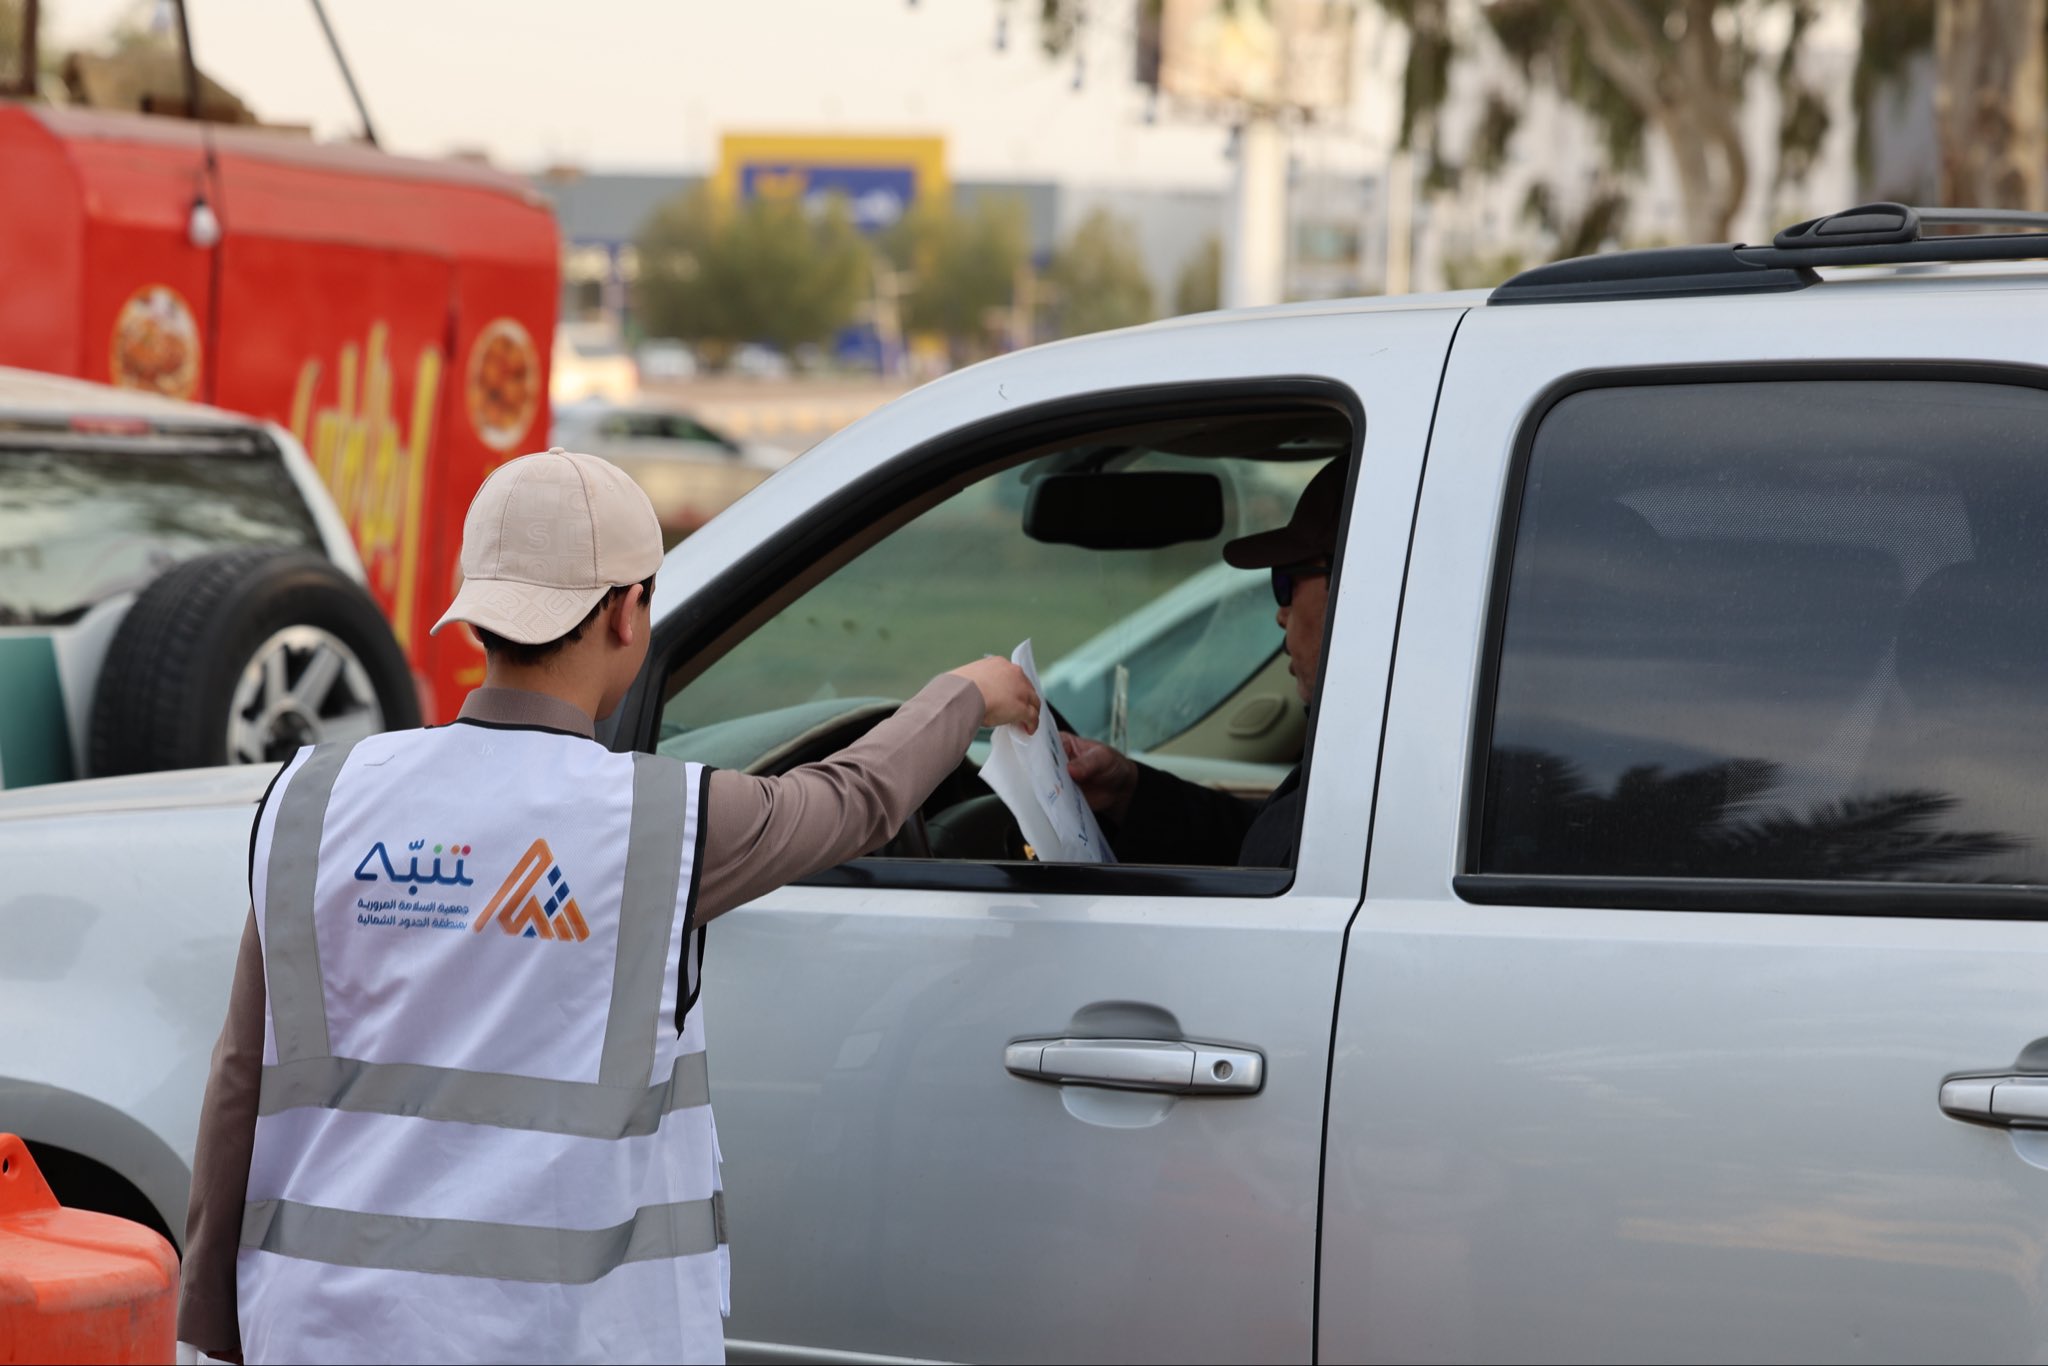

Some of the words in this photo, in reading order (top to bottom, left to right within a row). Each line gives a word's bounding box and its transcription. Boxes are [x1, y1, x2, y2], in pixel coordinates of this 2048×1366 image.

[357, 898, 396, 912] المرورية
[398, 900, 436, 912] السلامة
[437, 902, 469, 915] جمعية
[357, 913, 396, 926] الشمالية
[399, 917, 430, 929] الحدود
[432, 917, 468, 930] بمنطقة
